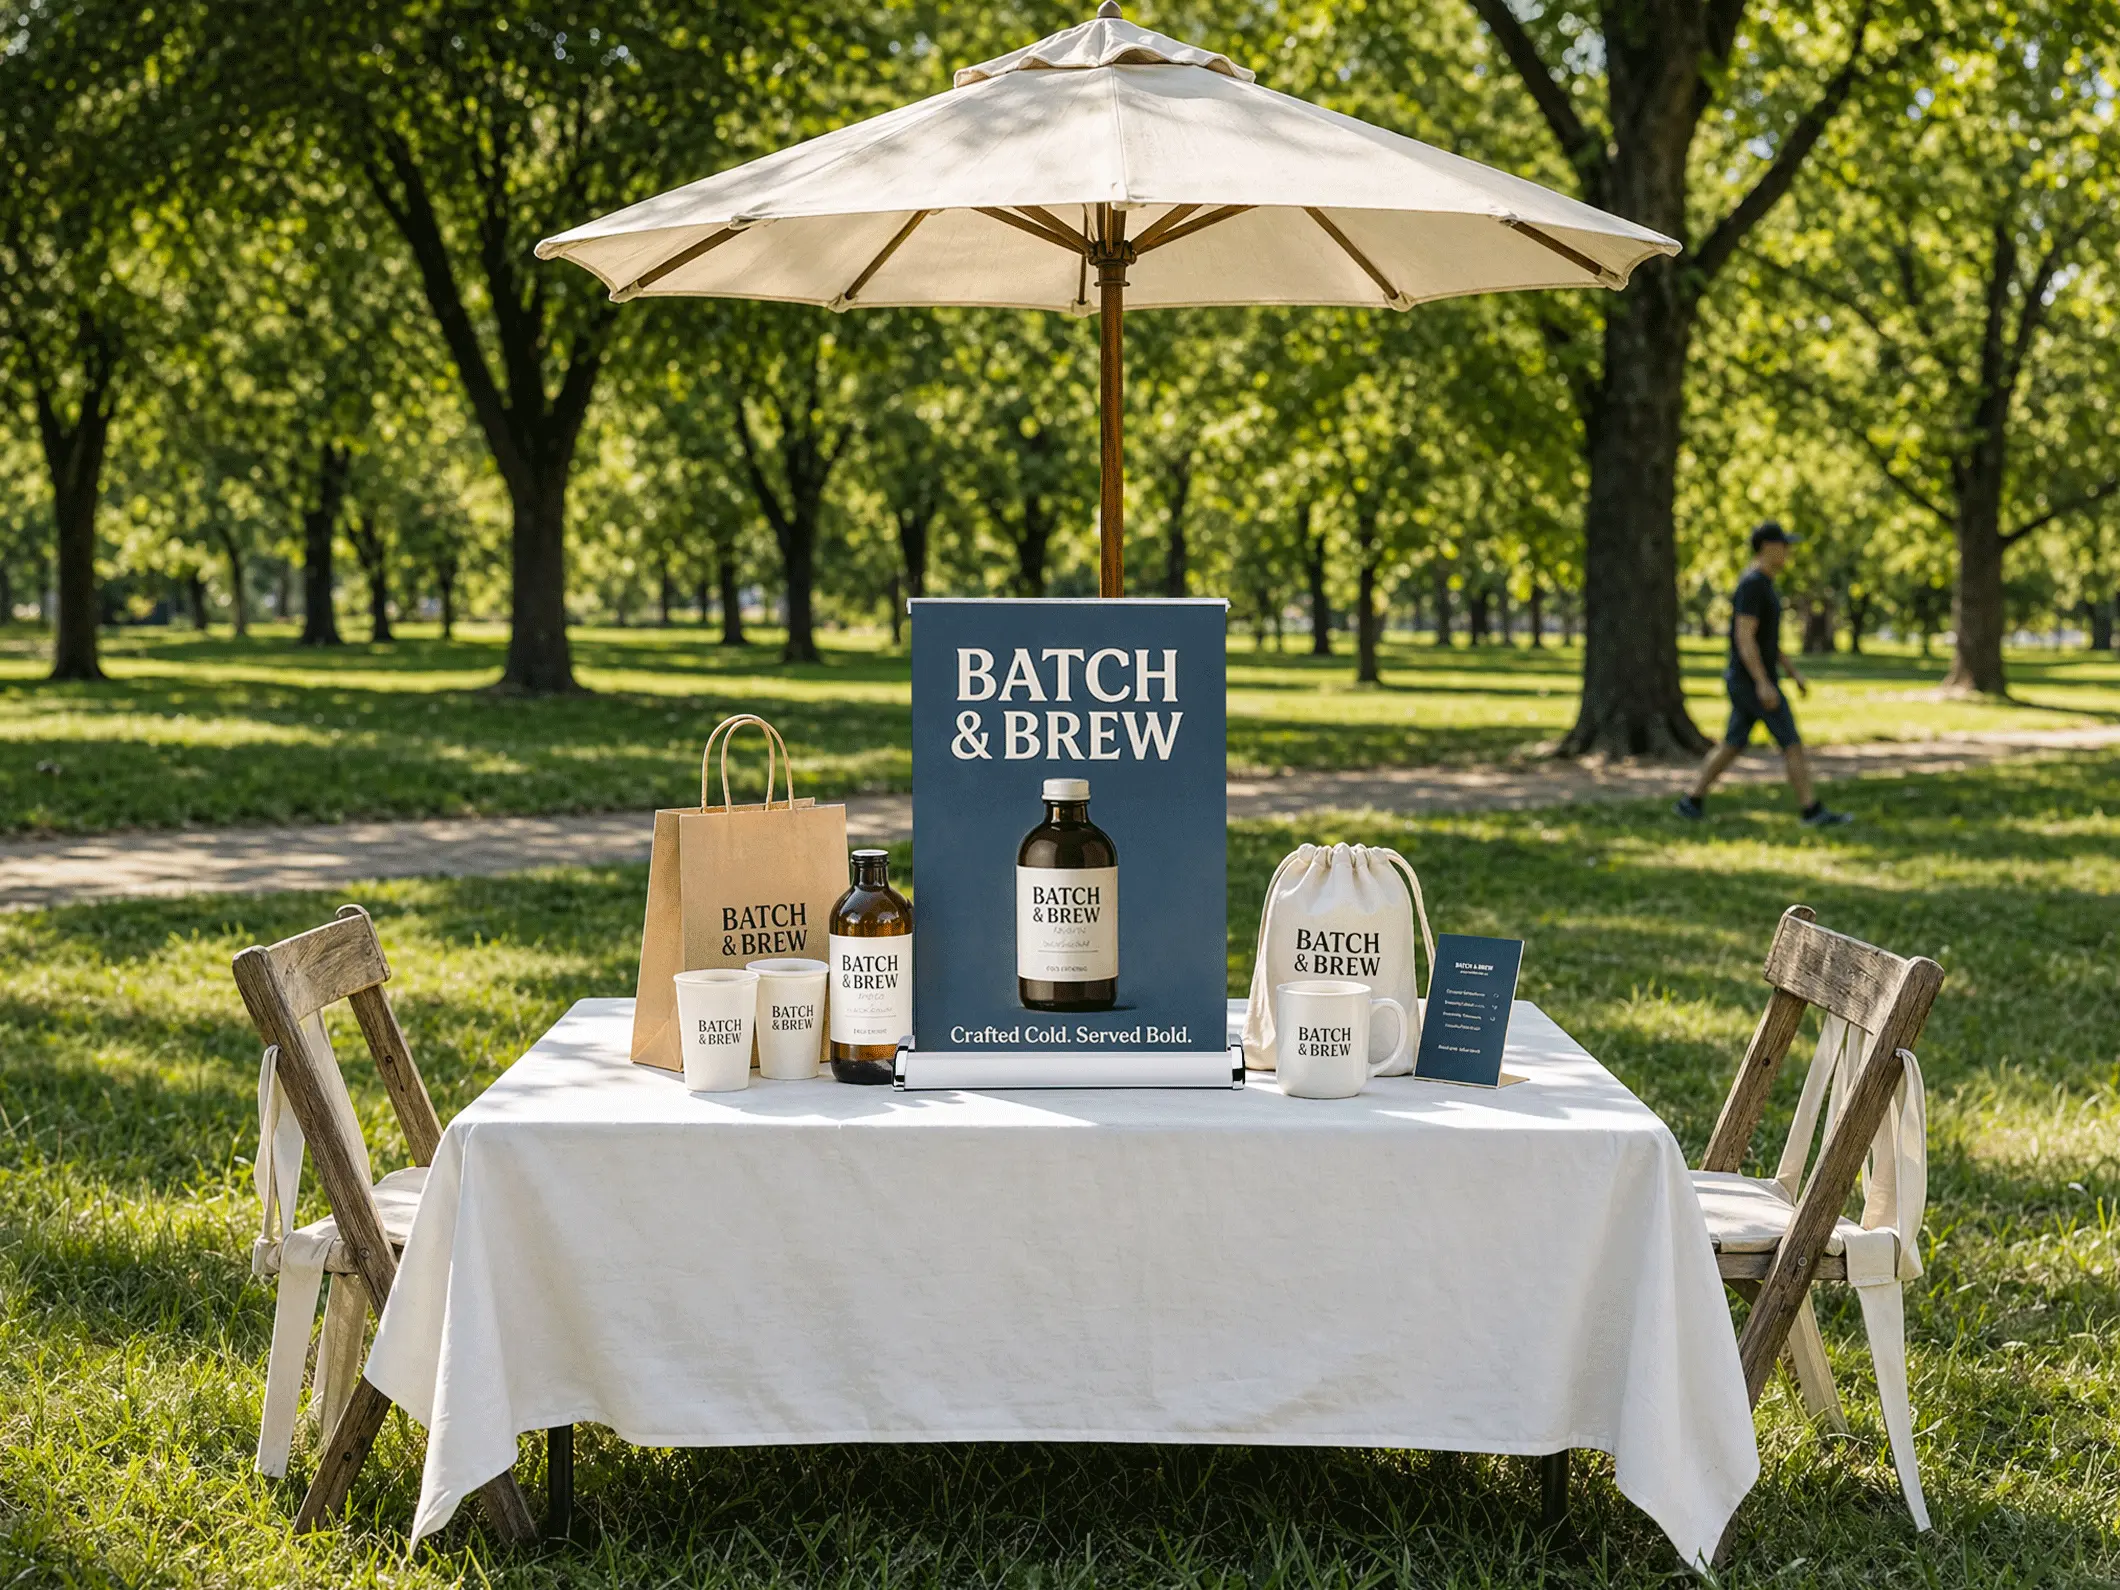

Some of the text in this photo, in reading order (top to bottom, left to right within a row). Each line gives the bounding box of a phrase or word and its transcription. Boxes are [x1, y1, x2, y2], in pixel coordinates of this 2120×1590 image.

[956, 648, 1179, 702] BATCH
[951, 710, 1184, 761] & BREW
[1033, 886, 1100, 905] BATCH
[722, 903, 807, 931] BATCH
[1033, 907, 1101, 924] & BREW
[722, 929, 808, 956] & BREW
[1296, 928, 1380, 954] BATCH
[842, 954, 898, 973] BATCH
[1294, 953, 1381, 977] & BREW
[772, 1004, 814, 1019] BATCH
[698, 1018, 742, 1032] BATCH
[950, 1025, 1192, 1044] Crafted Cold. Served Bold.
[1299, 1026, 1351, 1042] BATCH
